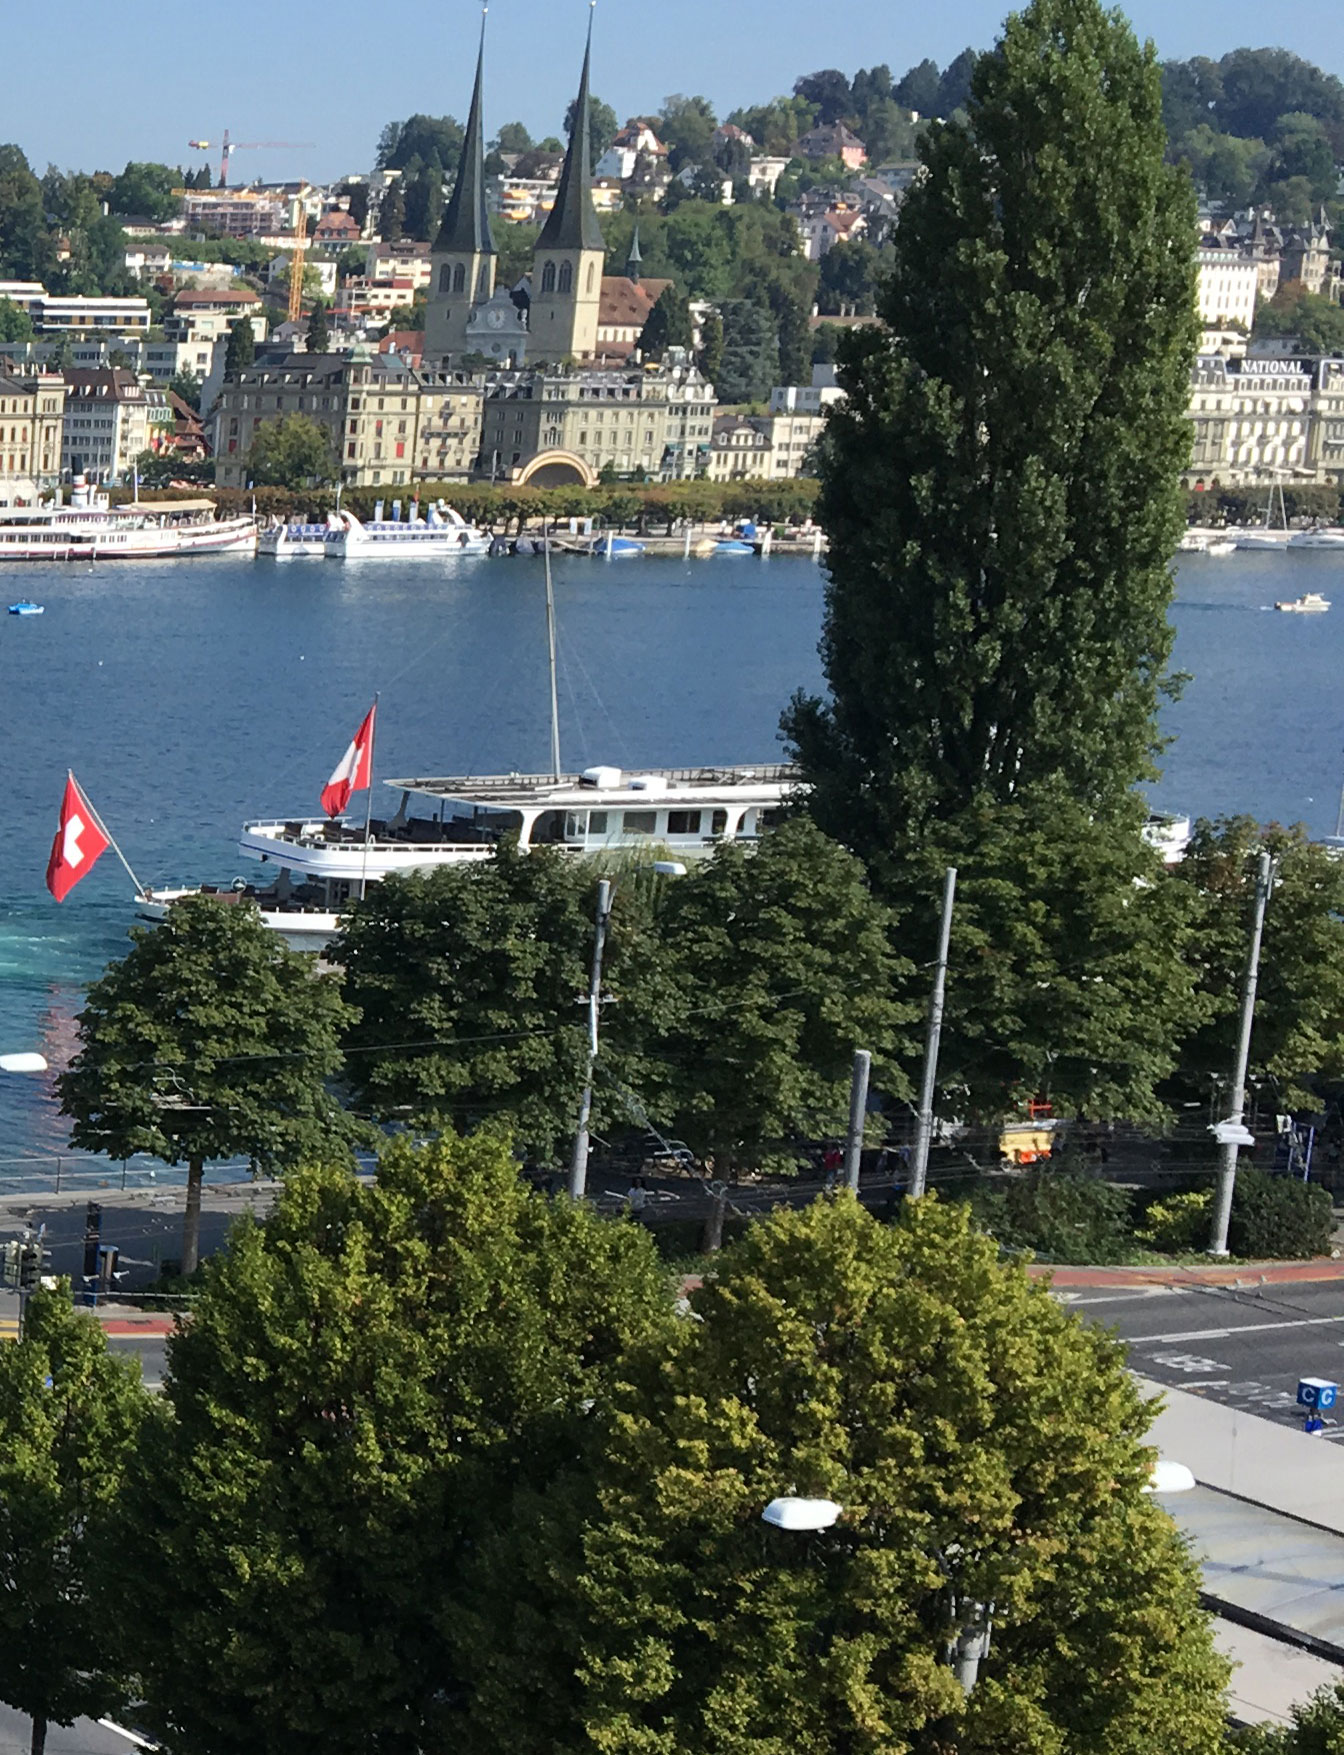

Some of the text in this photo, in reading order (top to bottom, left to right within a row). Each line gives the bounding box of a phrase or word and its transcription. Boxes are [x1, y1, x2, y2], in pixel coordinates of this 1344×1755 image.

[1241, 359, 1304, 374] NATIONAL
[1302, 1387, 1316, 1403] C
[1321, 1389, 1333, 1405] C
